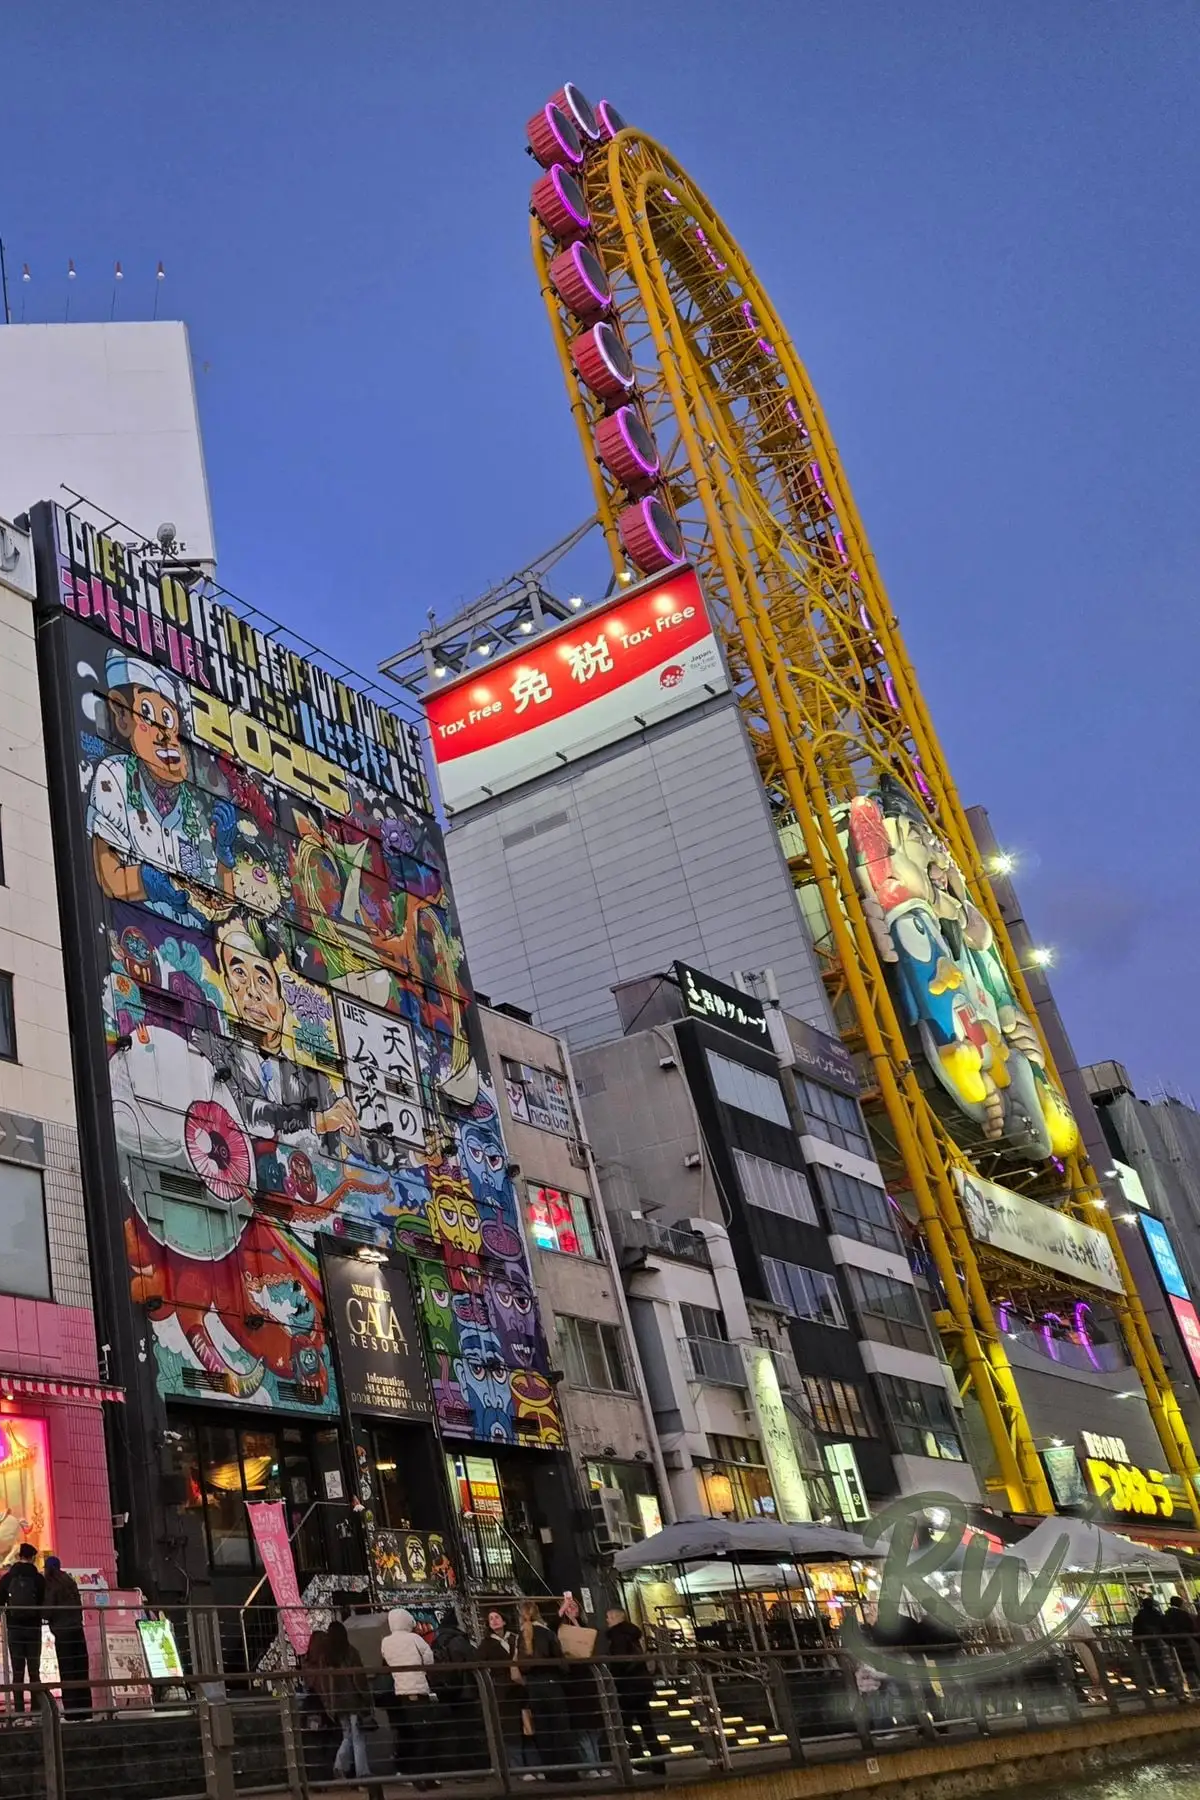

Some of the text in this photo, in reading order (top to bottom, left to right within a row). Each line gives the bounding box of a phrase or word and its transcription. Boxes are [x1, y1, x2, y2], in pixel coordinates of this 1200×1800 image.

[621, 604, 696, 649] Tax Free
[509, 634, 615, 715] 免税
[439, 701, 502, 739] Tax Free
[189, 684, 352, 817] 2025
[346, 1297, 407, 1342] GALA
[349, 1333, 410, 1356] RESORT
